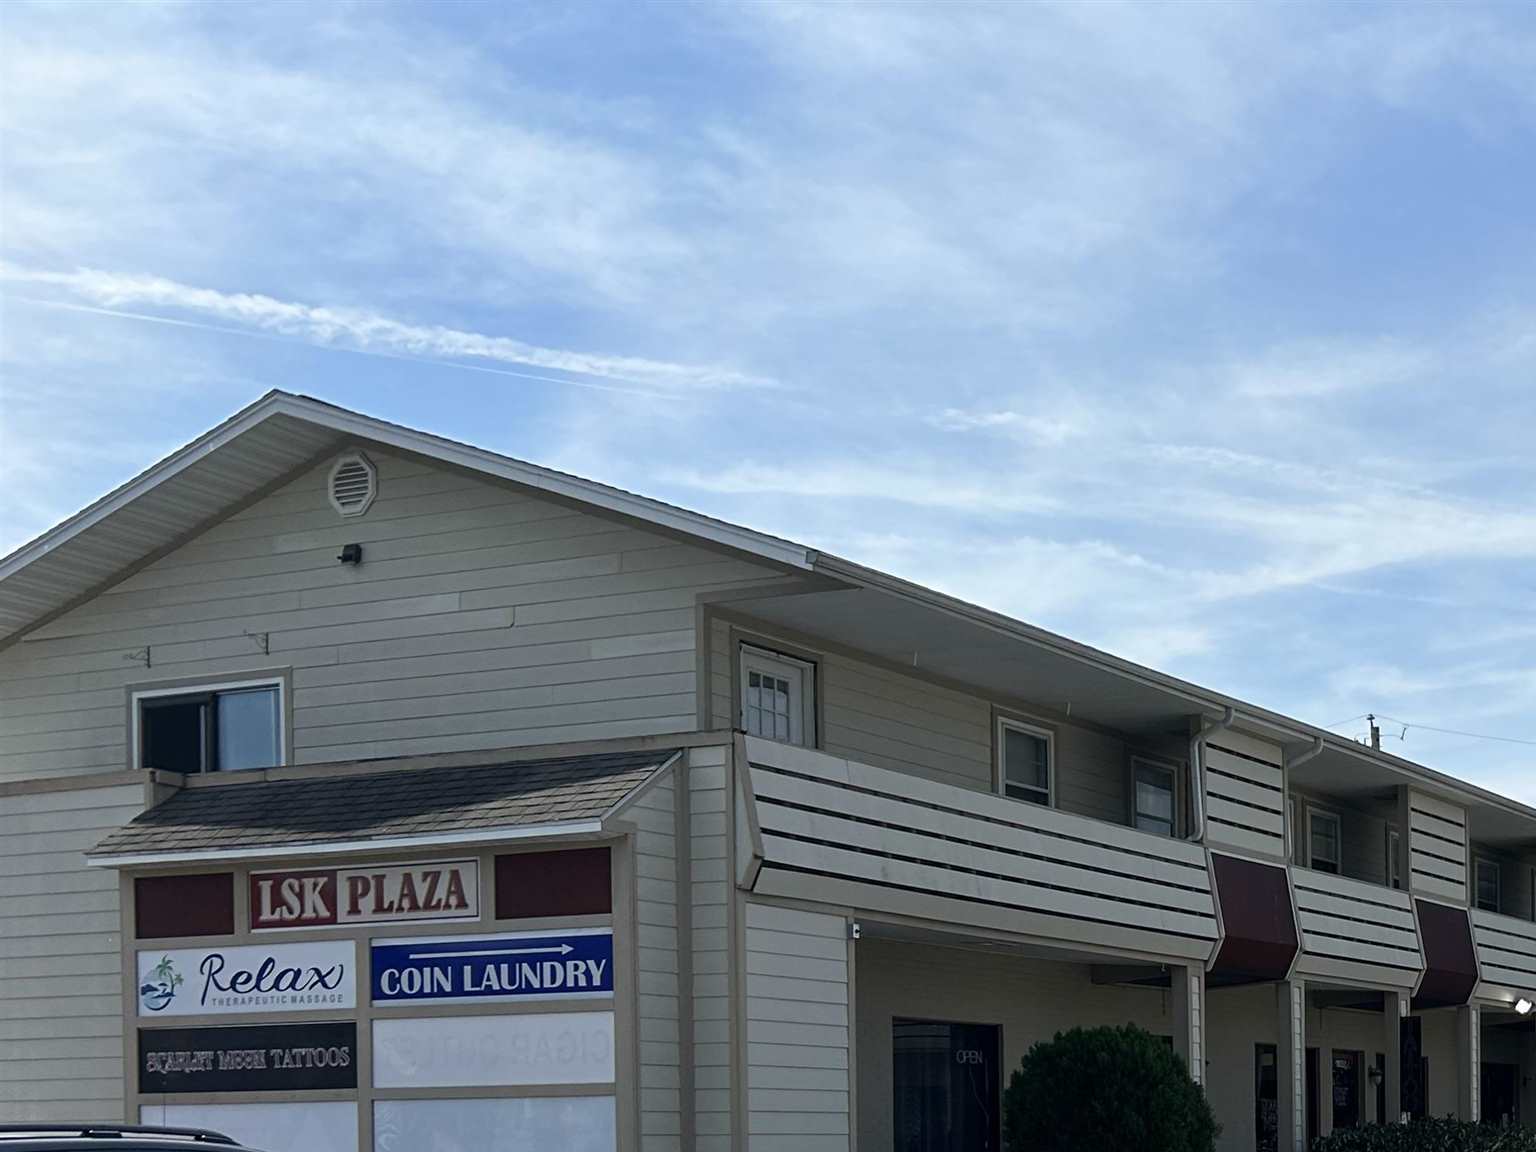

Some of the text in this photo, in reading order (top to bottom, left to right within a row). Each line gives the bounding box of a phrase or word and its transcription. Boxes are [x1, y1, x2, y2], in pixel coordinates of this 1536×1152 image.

[258, 869, 469, 921] LSK PLAZA
[200, 953, 344, 1006] Relax
[380, 958, 607, 995] COIN LAUNDRY
[212, 994, 343, 1006] THERAPEUTIC MASSAGE
[270, 1047, 350, 1068] TATTOOS
[956, 1049, 983, 1064] OPEN
